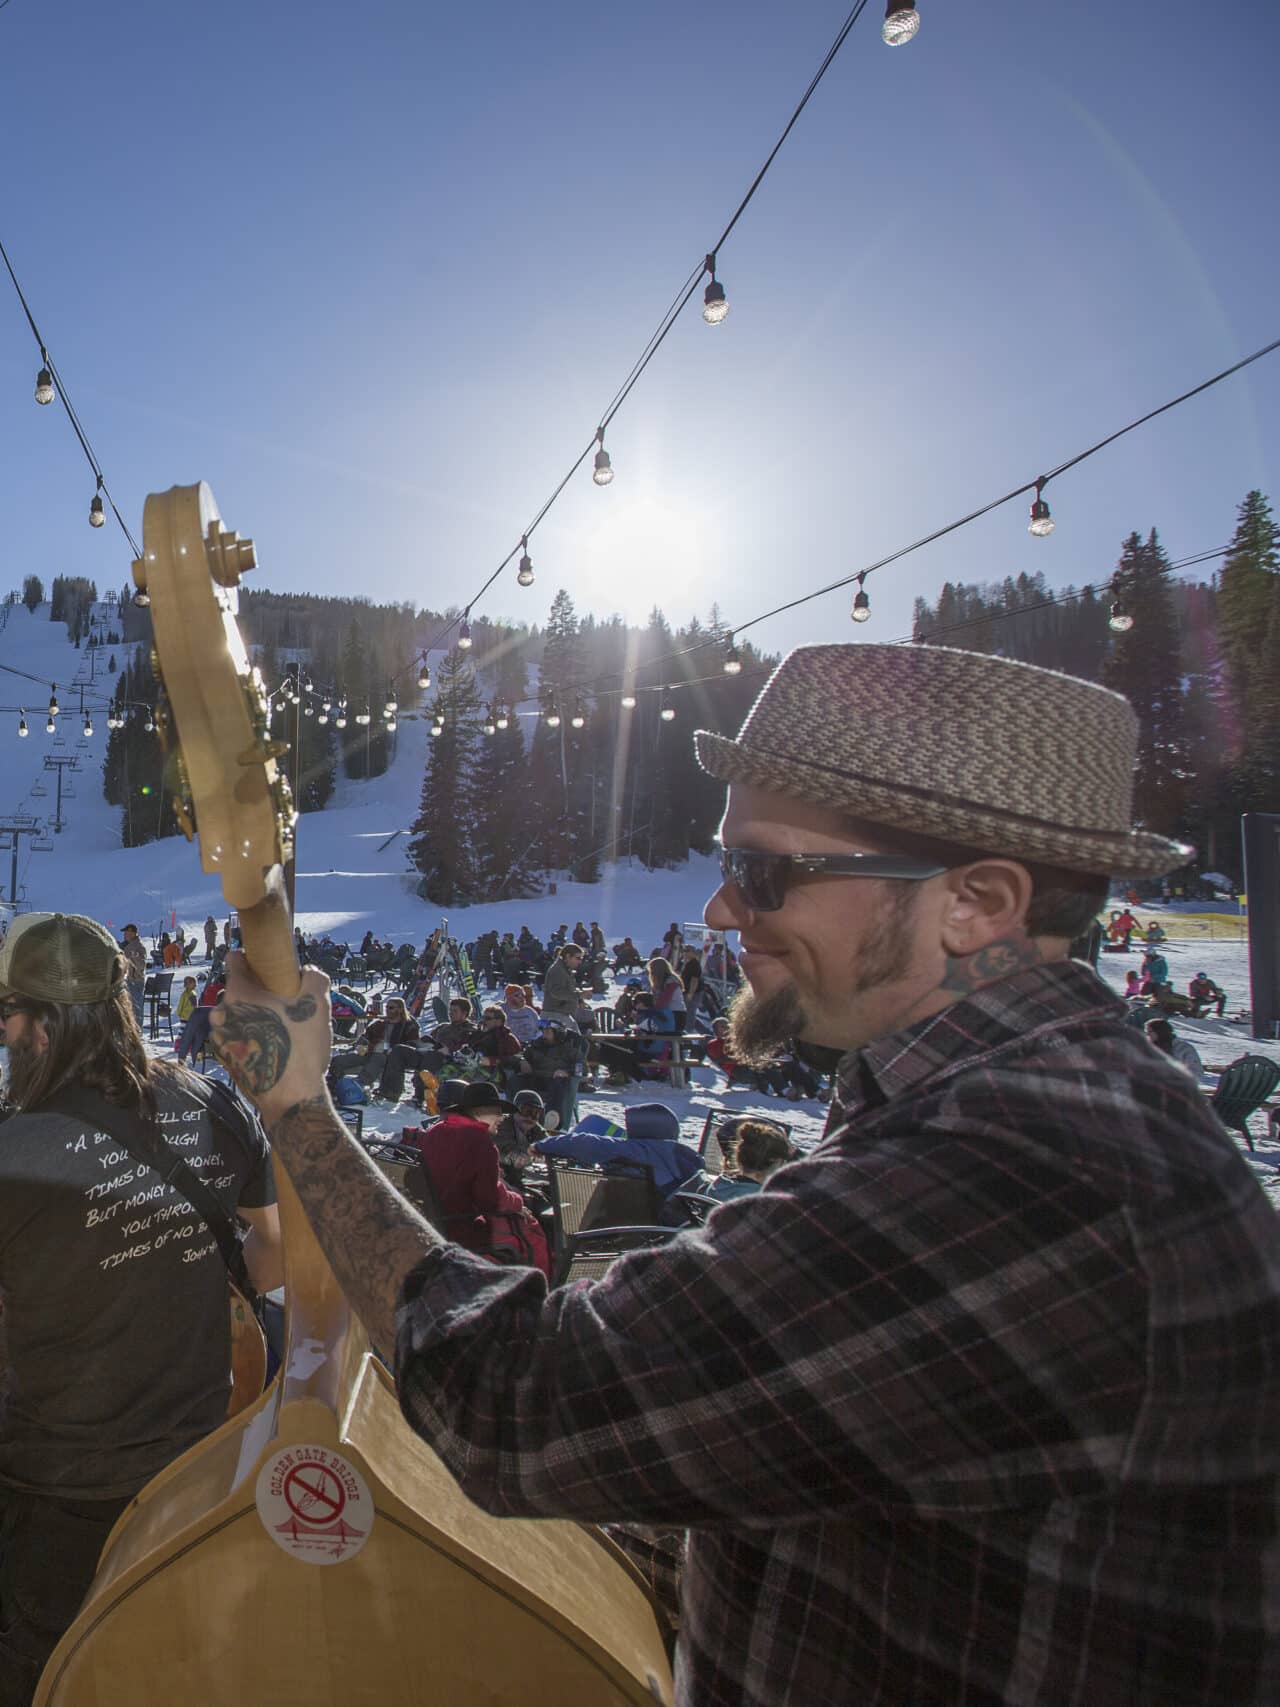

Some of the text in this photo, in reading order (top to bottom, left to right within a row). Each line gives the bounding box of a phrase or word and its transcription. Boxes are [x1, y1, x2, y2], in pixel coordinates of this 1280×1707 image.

[182, 1108, 207, 1122] GET
[98, 1149, 129, 1169] YOU
[86, 1172, 133, 1200] TIMES
[86, 1201, 122, 1228] BUT
[125, 1184, 165, 1209] MONEY
[214, 1174, 236, 1189] GET
[121, 1217, 151, 1239] YOU
[99, 1242, 151, 1270] TIMES
[154, 1228, 173, 1250] OF
[173, 1225, 194, 1240] NO
[271, 1448, 360, 1501] GOLDEN GATE BRIDGE
